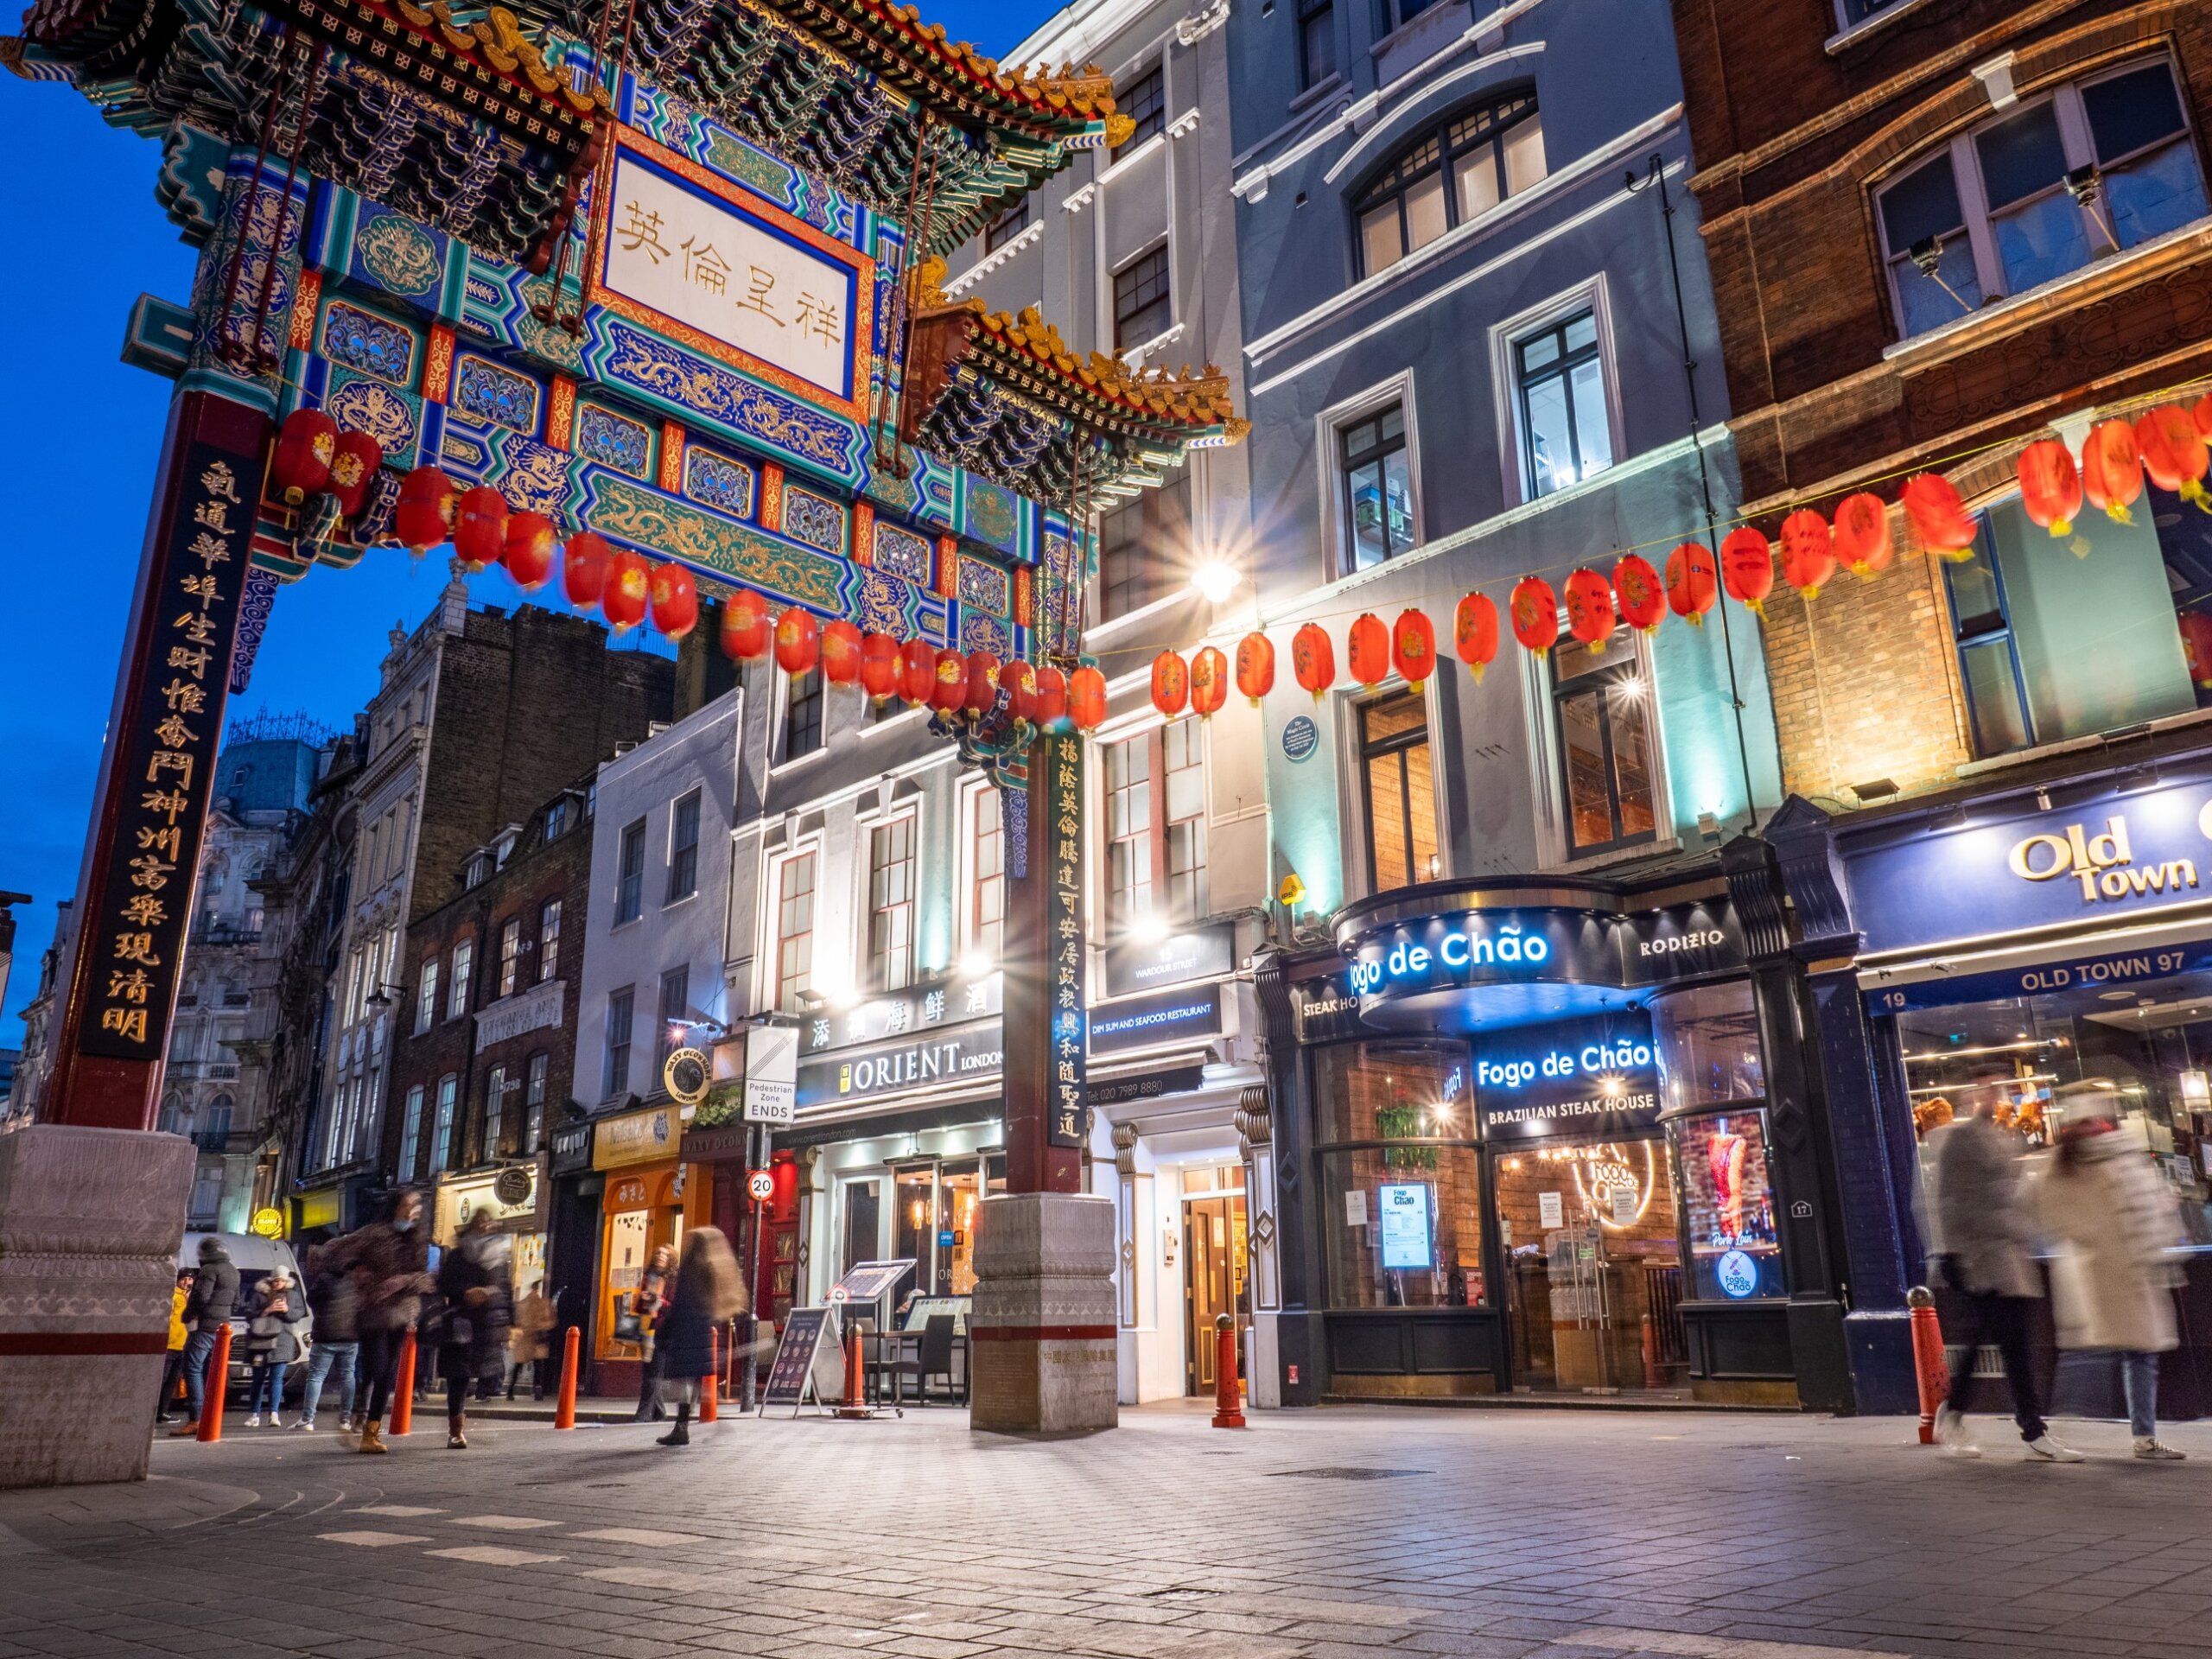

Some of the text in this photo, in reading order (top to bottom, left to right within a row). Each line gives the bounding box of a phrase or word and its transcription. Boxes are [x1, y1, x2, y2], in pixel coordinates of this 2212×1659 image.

[614, 200, 841, 350] 英倫呈祥
[2009, 816, 2133, 881] Old
[2070, 859, 2199, 901] Town
[1640, 930, 1725, 957] RODIZIO
[1159, 947, 1173, 962] 15
[1350, 926, 1548, 995] ogo de Chão
[1135, 957, 1198, 978] WARDOUR STREET
[2021, 951, 2185, 992] OLD TOWN 97
[1303, 999, 1338, 1017] STEAK
[1882, 992, 1906, 1008] 19
[1092, 1003, 1211, 1034] DIM SUM AND SEAFOOD RESTAURANT
[666, 1051, 683, 1072] WAXY
[855, 1043, 961, 1090] ORIENT
[961, 1052, 1003, 1071] LONDON
[1478, 1061, 1536, 1088] Fogo
[1541, 1052, 1574, 1077] de
[1580, 1039, 1650, 1071] Chão
[503, 1078, 521, 1093] 1798
[749, 1083, 792, 1095] Pedestrian
[1086, 1080, 1163, 1103] Tel: 020 7989 8880
[676, 1091, 698, 1102] LONDON
[760, 1093, 780, 1103] Zone
[751, 1104, 788, 1118] ENDS
[1489, 1094, 1655, 1126] BRAZILIAN STEAK HOUSE
[753, 1179, 772, 1192] 20
[1796, 1205, 1808, 1215] 17
[1712, 1230, 1753, 1247] Pork Loin
[1725, 1275, 1745, 1284] Fogo
